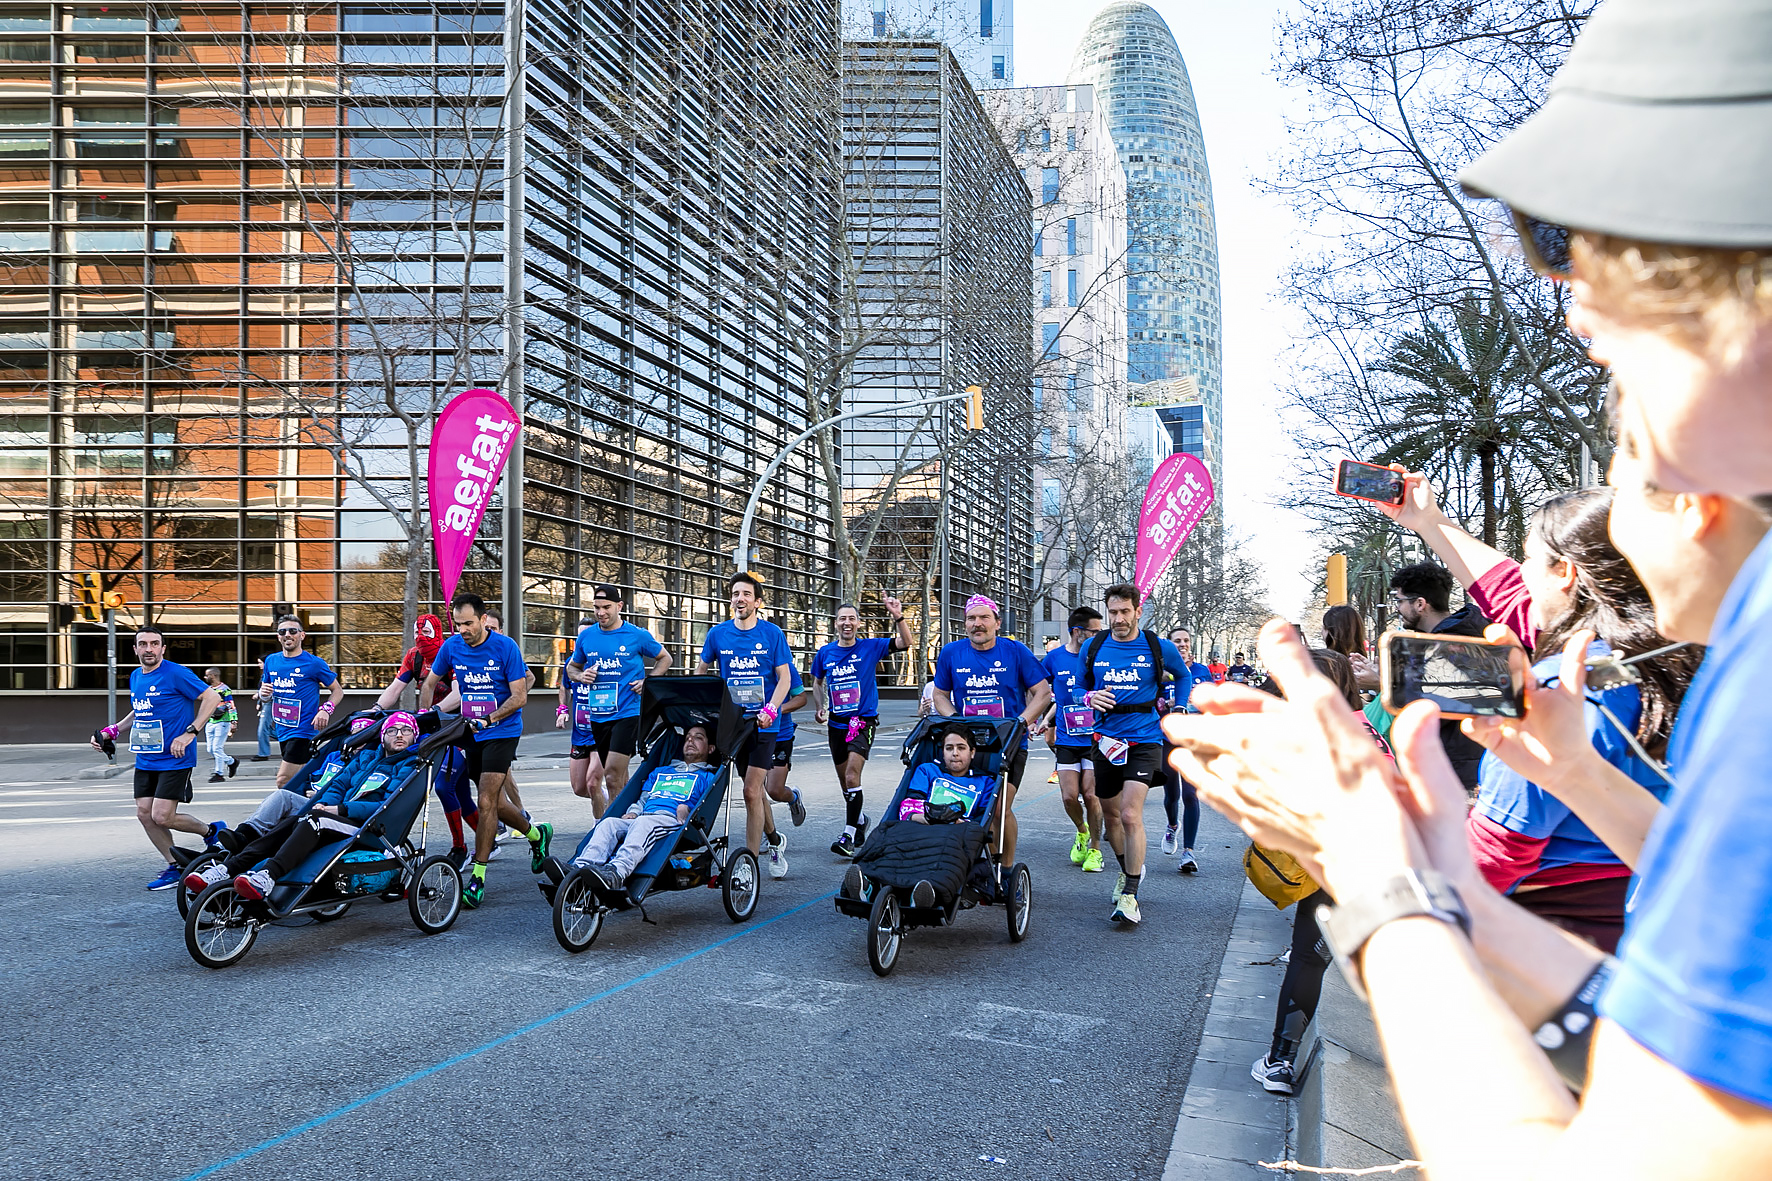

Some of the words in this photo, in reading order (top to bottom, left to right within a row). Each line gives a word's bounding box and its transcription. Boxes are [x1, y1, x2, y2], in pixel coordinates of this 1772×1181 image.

[444, 413, 508, 531] aefat
[463, 422, 515, 537] www.aefat.es
[1150, 471, 1200, 545] aefat
[1160, 486, 1205, 550] www.aefat.es
